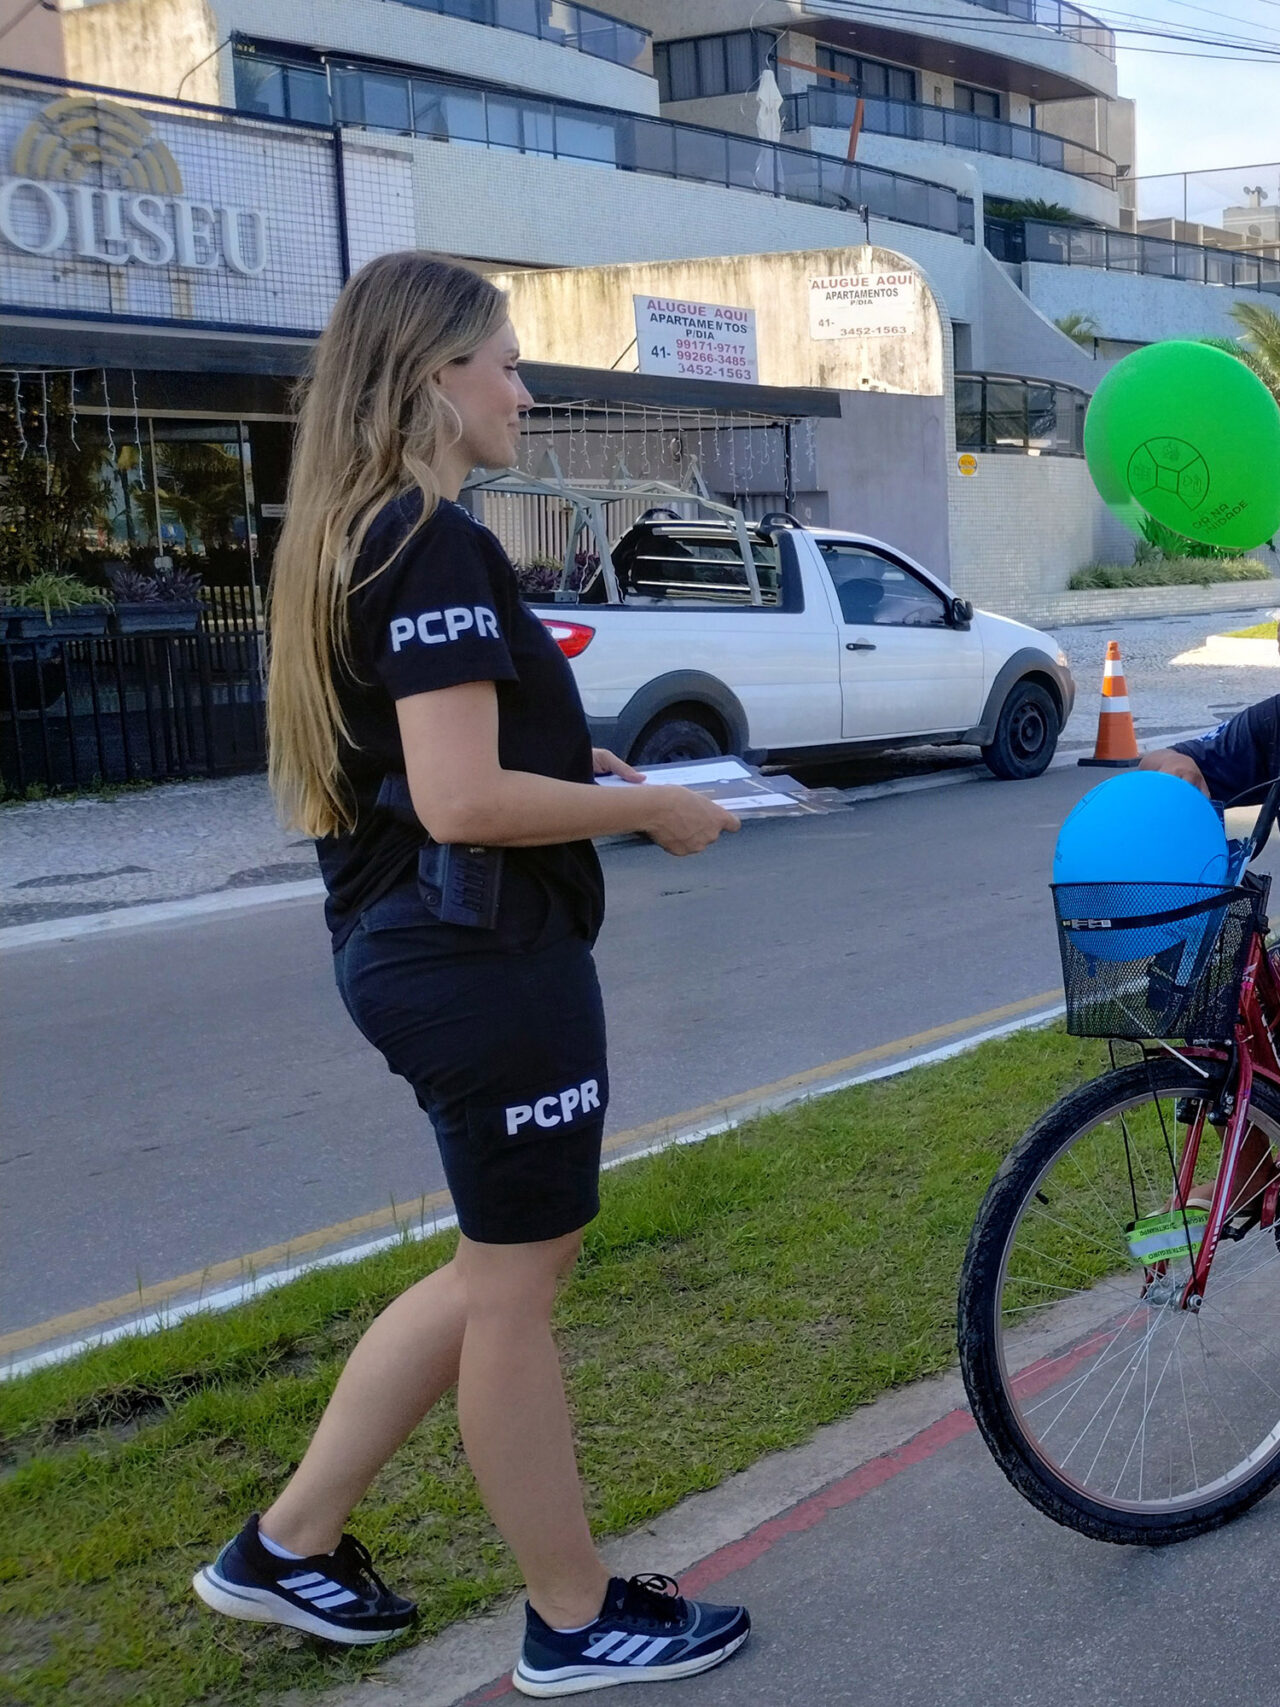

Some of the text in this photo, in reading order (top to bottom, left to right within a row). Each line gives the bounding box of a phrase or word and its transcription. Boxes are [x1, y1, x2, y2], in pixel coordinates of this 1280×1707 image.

[811, 275, 912, 290] ALUGUE AQUI
[826, 288, 899, 300] APARTAMENTOS
[647, 300, 748, 322] ALUGUE AQUI
[650, 313, 747, 334] APARTAMENTOS
[840, 326, 907, 336] 3452-1563
[686, 328, 715, 340] P/DIA
[651, 345, 671, 358] 41-
[676, 339, 746, 354] 99171-9717
[676, 350, 746, 367] 99266-3485
[678, 363, 752, 380] 3452-1563
[390, 606, 500, 653] PCPR
[505, 1079, 601, 1136] PCPR
